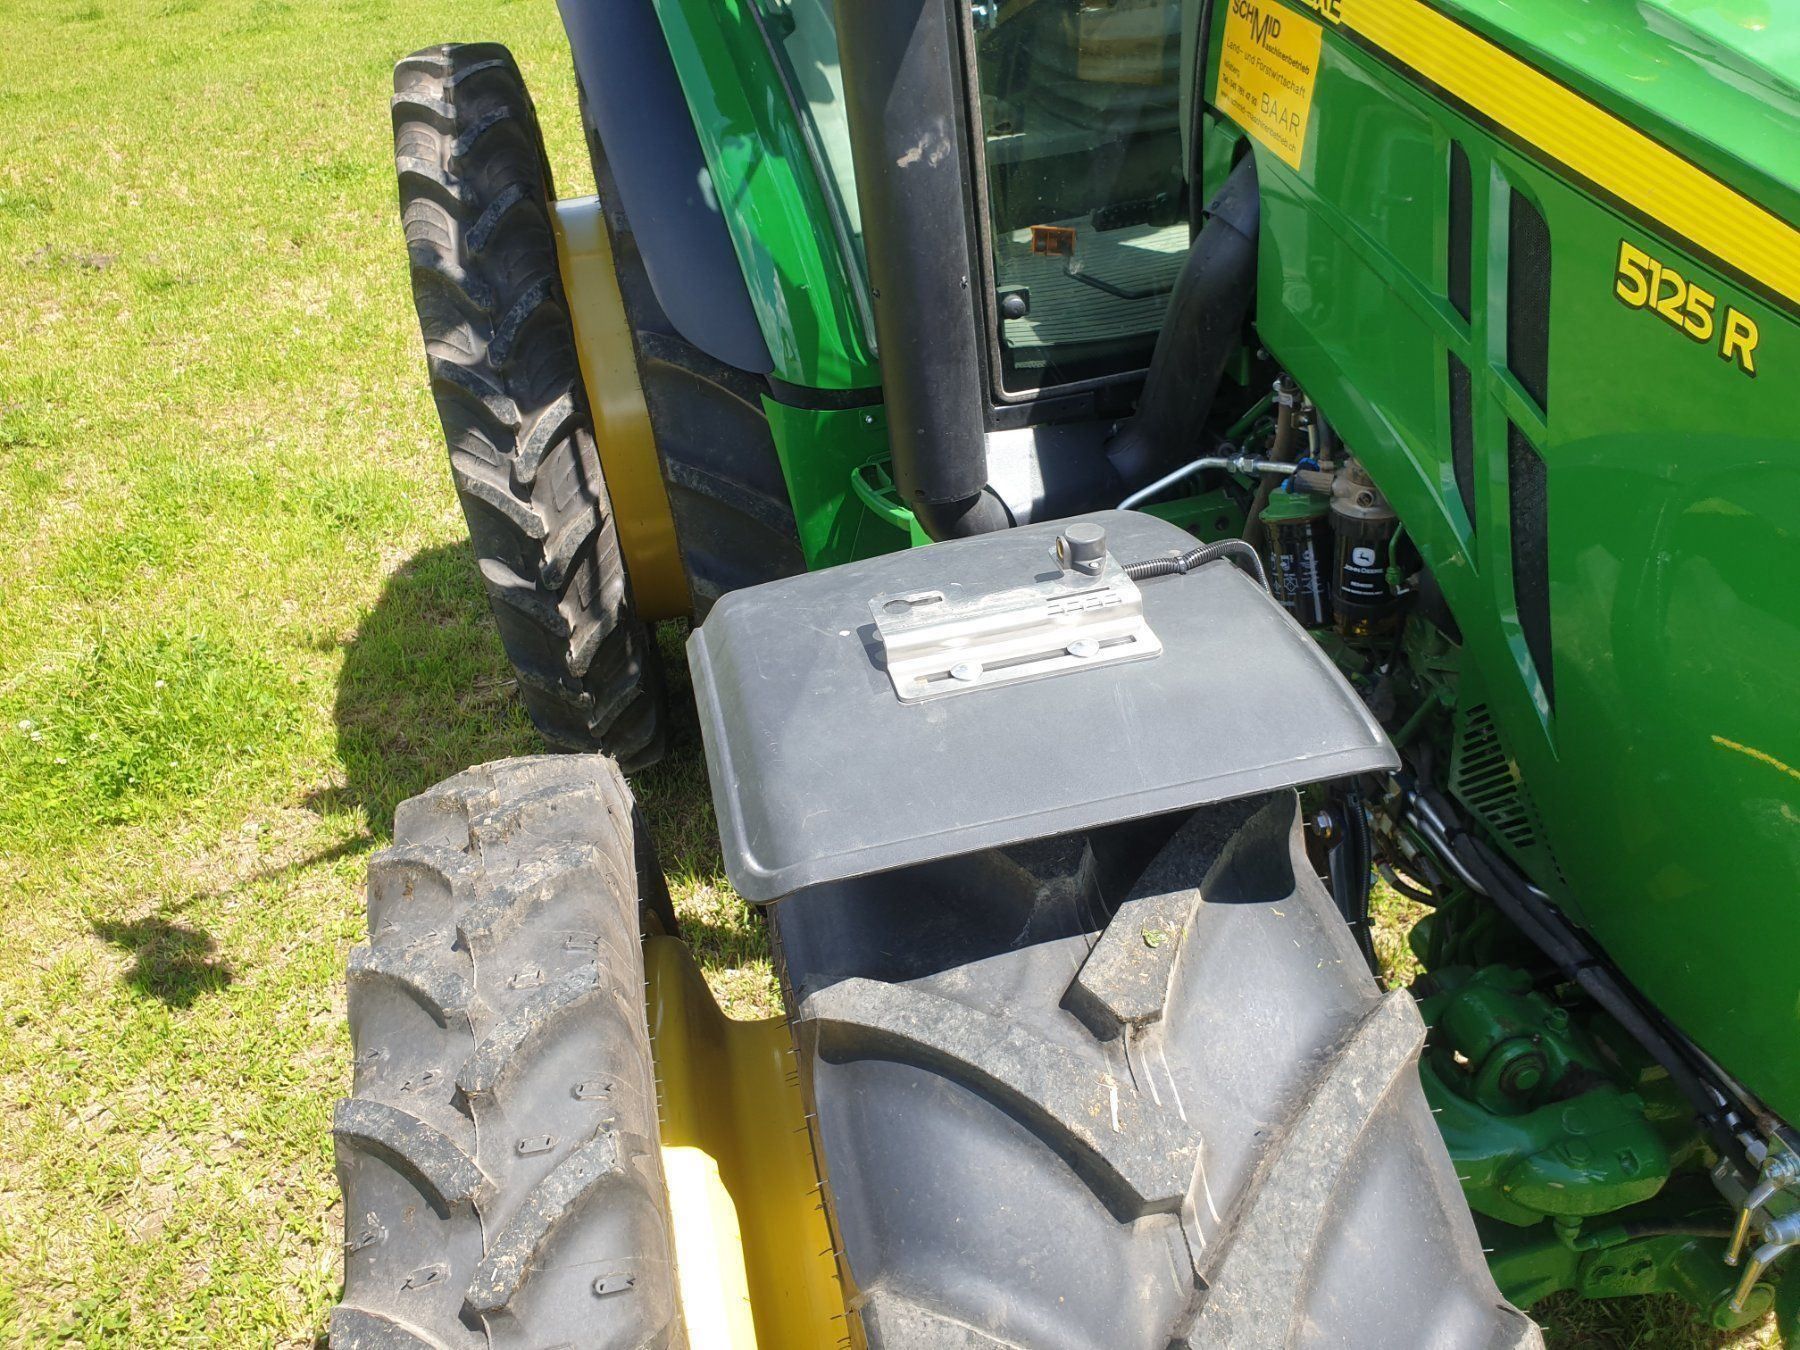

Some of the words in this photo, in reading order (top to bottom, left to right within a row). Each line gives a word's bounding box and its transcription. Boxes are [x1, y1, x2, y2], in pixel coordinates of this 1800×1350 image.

[1232, 0, 1281, 48] SCHMID
[1244, 51, 1256, 65] und
[1256, 57, 1306, 98] Forstwirtschaft
[1260, 92, 1300, 138] BAAR
[1614, 238, 1716, 342] 5125
[1719, 305, 1759, 376] R
